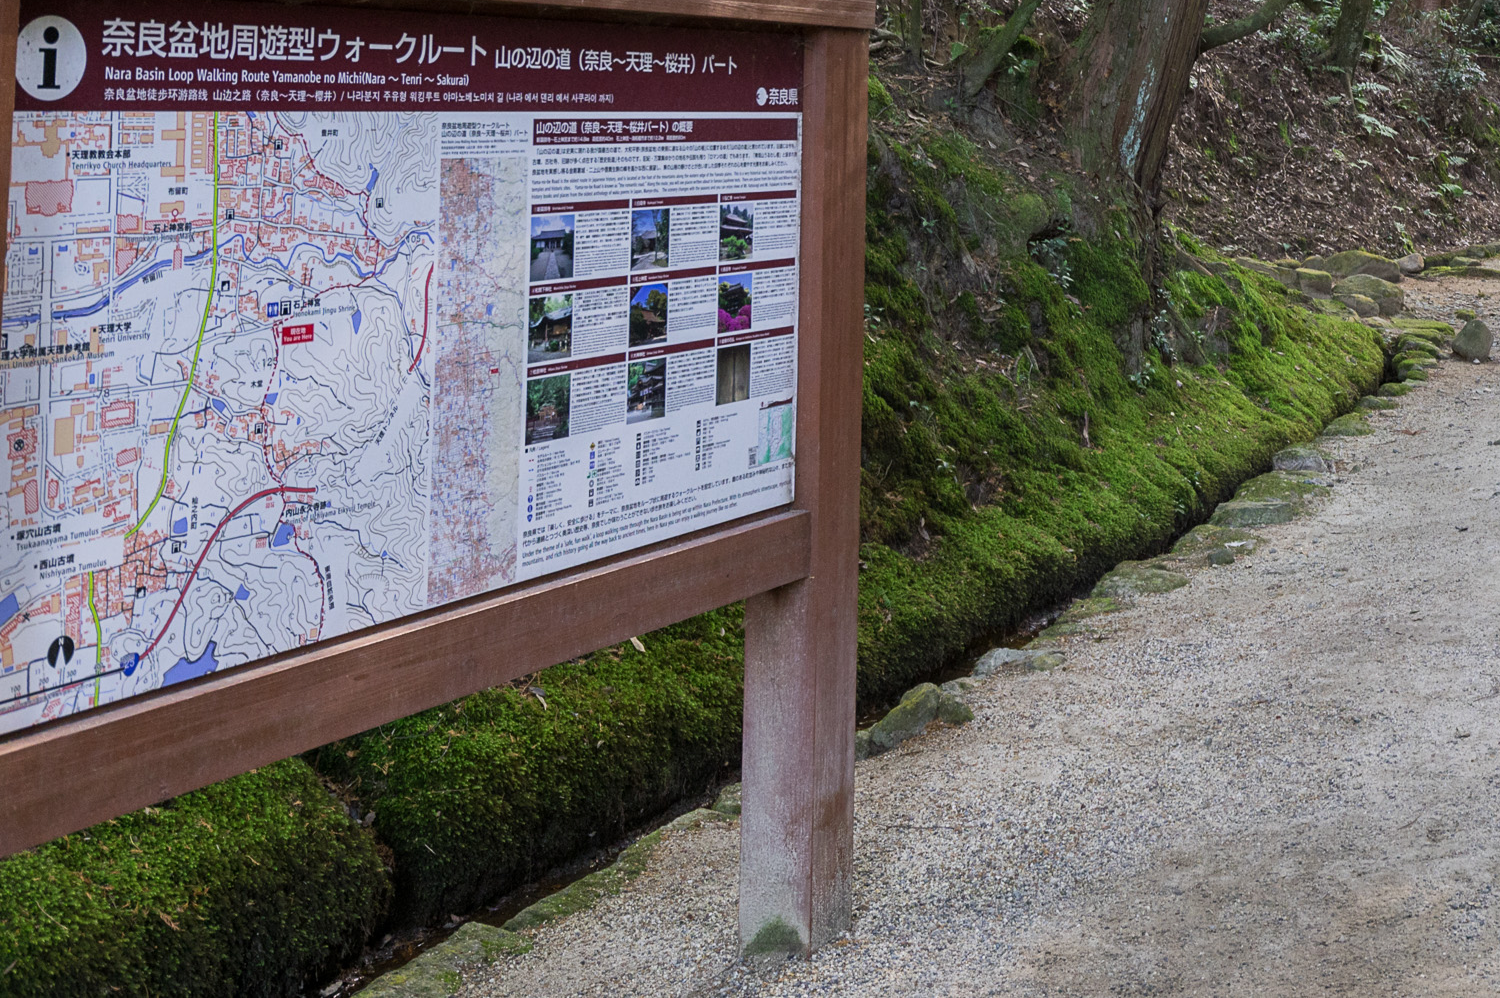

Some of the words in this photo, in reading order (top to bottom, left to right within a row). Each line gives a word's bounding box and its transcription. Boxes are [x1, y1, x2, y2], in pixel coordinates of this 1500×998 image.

[101, 17, 488, 67] 奈良盆地周遊型ウォークルート
[105, 67, 132, 81] Nara
[135, 67, 165, 82] Basin
[168, 68, 194, 84] Loop
[197, 69, 239, 86] Walking
[241, 70, 270, 83] Route
[272, 71, 322, 84] Yamanobe
[324, 74, 335, 84] no
[401, 73, 422, 86] Tenri
[436, 74, 470, 87] Sakurai)
[768, 88, 799, 106] 奈良県
[72, 162, 101, 171] Tenrikyo
[103, 160, 127, 170] Church
[128, 161, 172, 169] Headquarters
[98, 322, 132, 334] 天理大学
[117, 332, 151, 343] University
[283, 335, 292, 343] You
[70, 528, 99, 541] Tumulus
[39, 566, 76, 581] Nishiyama
[78, 559, 107, 572] Tumulus
